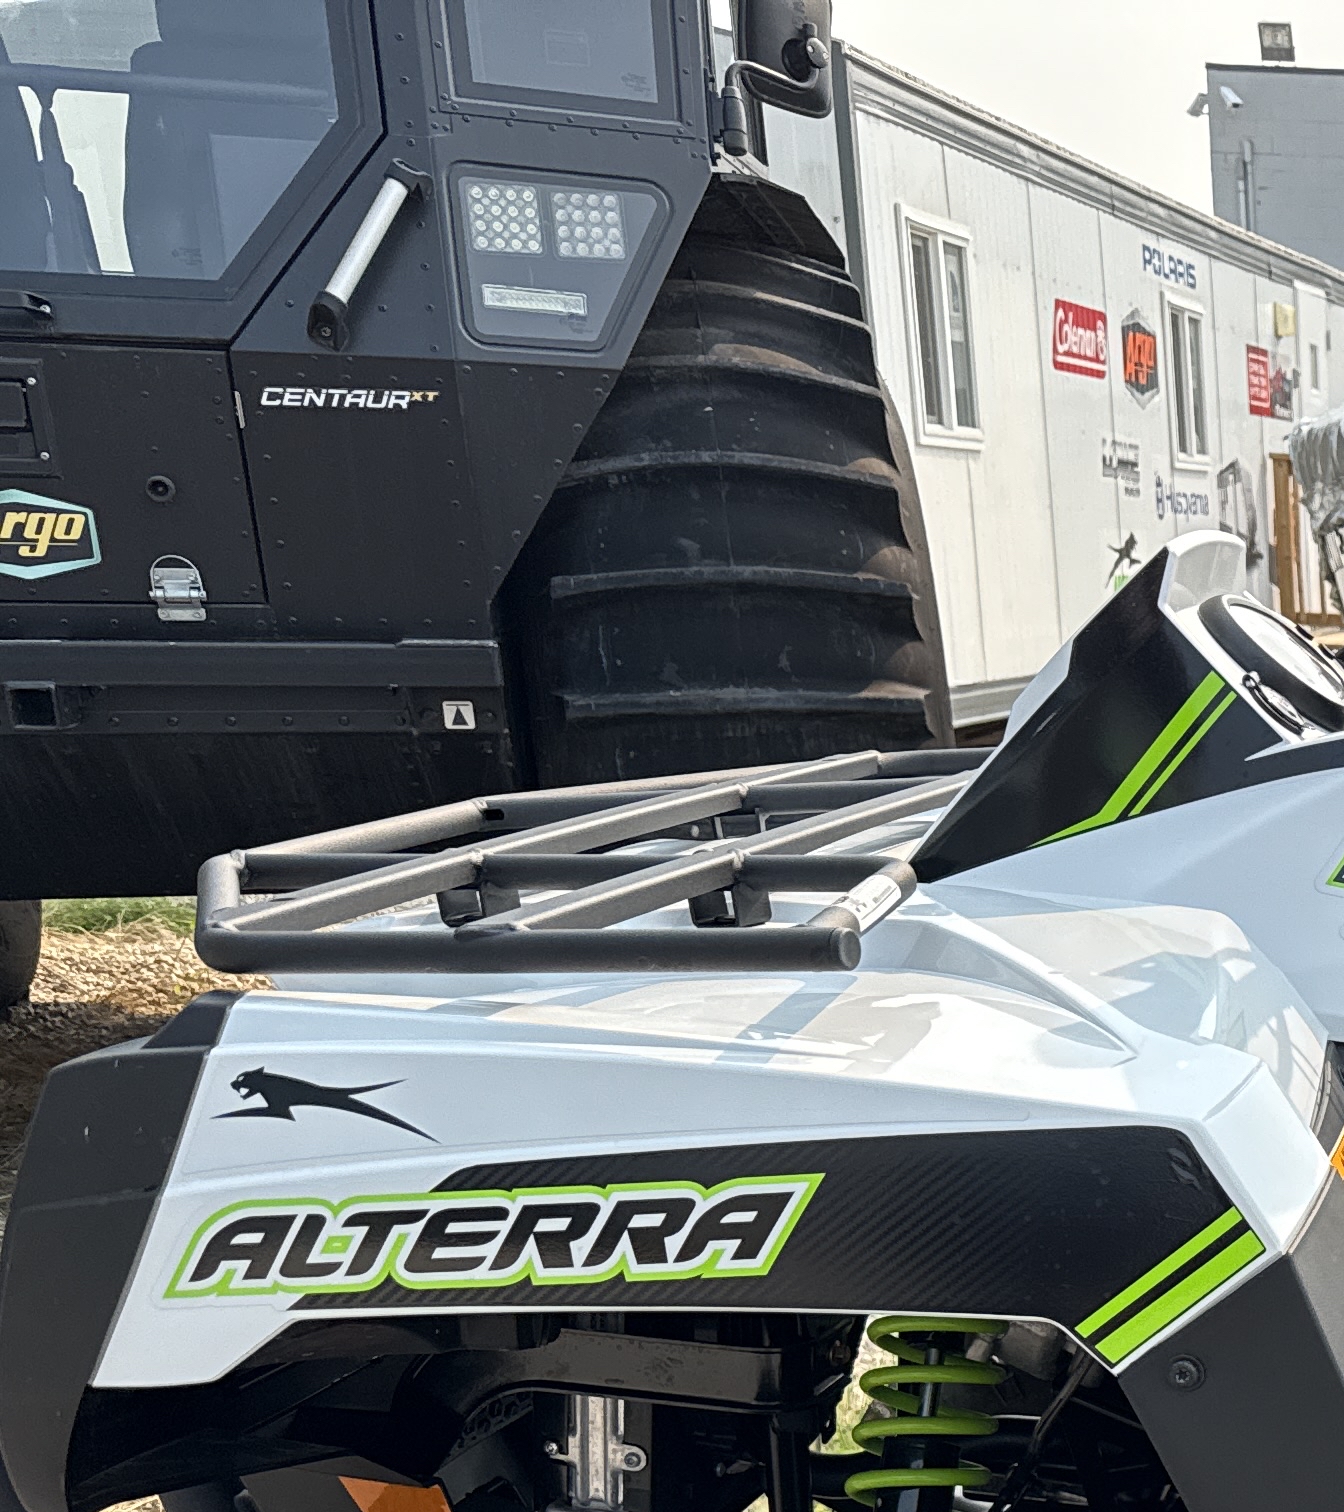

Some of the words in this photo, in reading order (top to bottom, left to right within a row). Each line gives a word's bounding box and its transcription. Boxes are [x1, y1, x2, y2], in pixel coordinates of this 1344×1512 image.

[1142, 244, 1197, 289] POLARIS
[260, 386, 411, 410] CENTAUR
[410, 390, 441, 402] XT
[0, 511, 86, 557] rgo
[183, 1186, 800, 1288] ALTERRA
